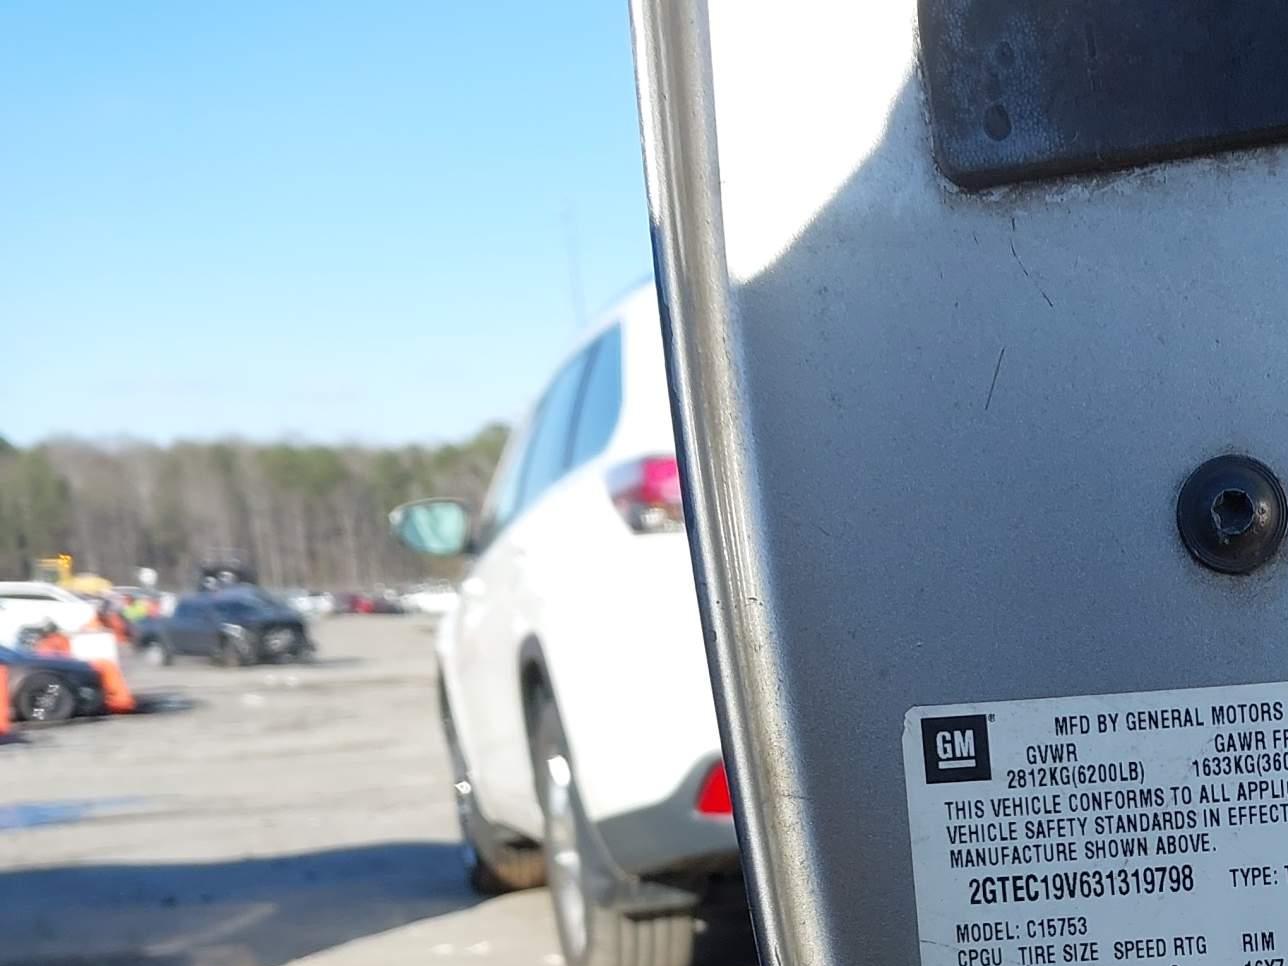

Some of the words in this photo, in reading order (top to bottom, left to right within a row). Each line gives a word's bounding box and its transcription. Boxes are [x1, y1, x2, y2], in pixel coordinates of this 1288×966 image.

[1055, 715, 1090, 736] MFD
[1097, 713, 1118, 733] BY
[1126, 708, 1204, 731] GENERAL
[1212, 702, 1283, 725] MOTORS
[1027, 743, 1078, 765] GVWR
[1214, 731, 1266, 753] GAWR
[1007, 761, 1144, 789] 2812KG(6200LB)
[944, 800, 984, 820] THIS
[990, 795, 1061, 817] VEHICLE
[1069, 788, 1164, 812] CONFORMS
[1170, 786, 1192, 806] TO
[1200, 784, 1230, 804] ALL
[946, 822, 1018, 844] VEHICLE
[1025, 817, 1087, 839] SAFETY
[1095, 810, 1197, 836] STANDARDS
[1204, 808, 1220, 827] IN
[1228, 803, 1288, 826] EFFECT
[950, 842, 1077, 868] MANUFACTURE
[1085, 837, 1148, 859] SHOWN
[1156, 833, 1216, 855] ABOVE.
[969, 864, 1193, 904] 2GTEC19V631319798
[1229, 867, 1277, 887] TYPE:
[956, 921, 1020, 943] MODEL:
[1027, 917, 1087, 938] C15753
[1242, 932, 1274, 952] RIM
[1018, 945, 1056, 965] TIRE
[1063, 942, 1099, 962] SIZE
[1114, 939, 1166, 960] SPEED
[1174, 936, 1207, 956] RTG
